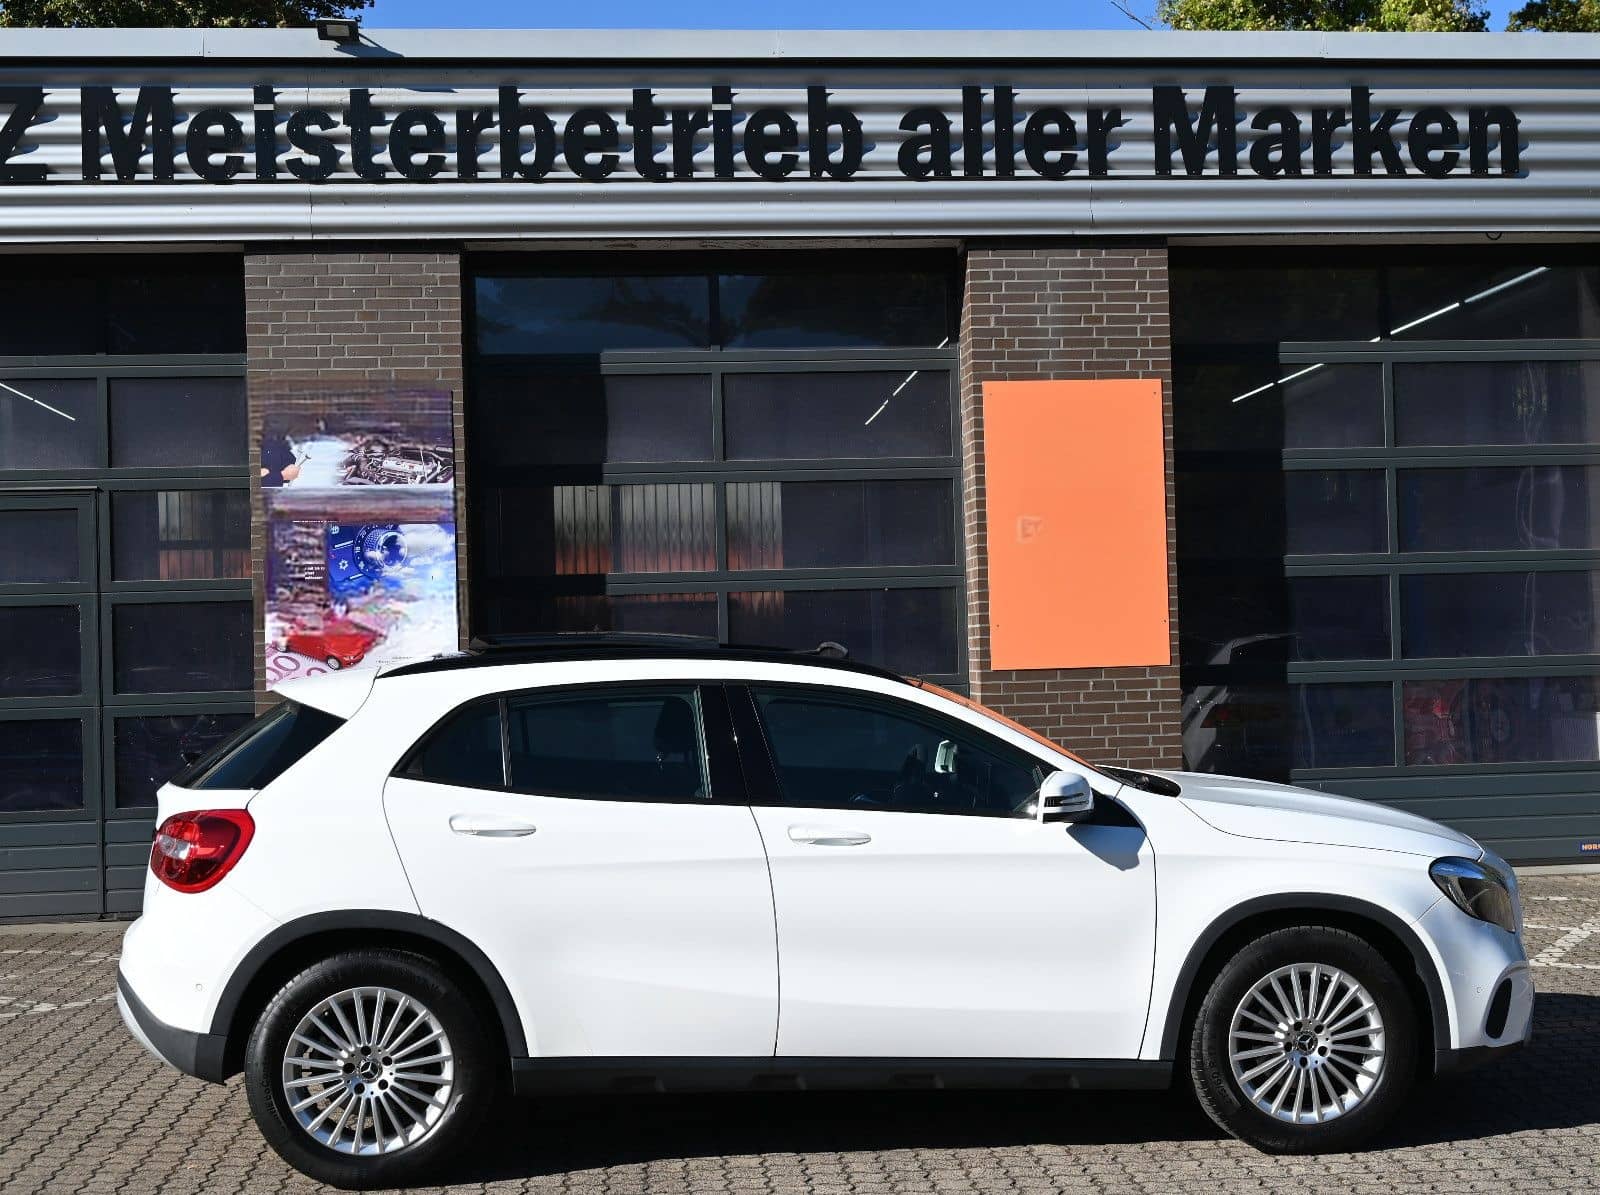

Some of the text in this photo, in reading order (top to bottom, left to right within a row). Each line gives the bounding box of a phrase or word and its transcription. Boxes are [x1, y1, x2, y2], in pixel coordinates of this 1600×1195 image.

[81, 86, 862, 180] Meisterbetrieb
[898, 86, 1122, 180] aller
[1153, 86, 1519, 178] Marken
